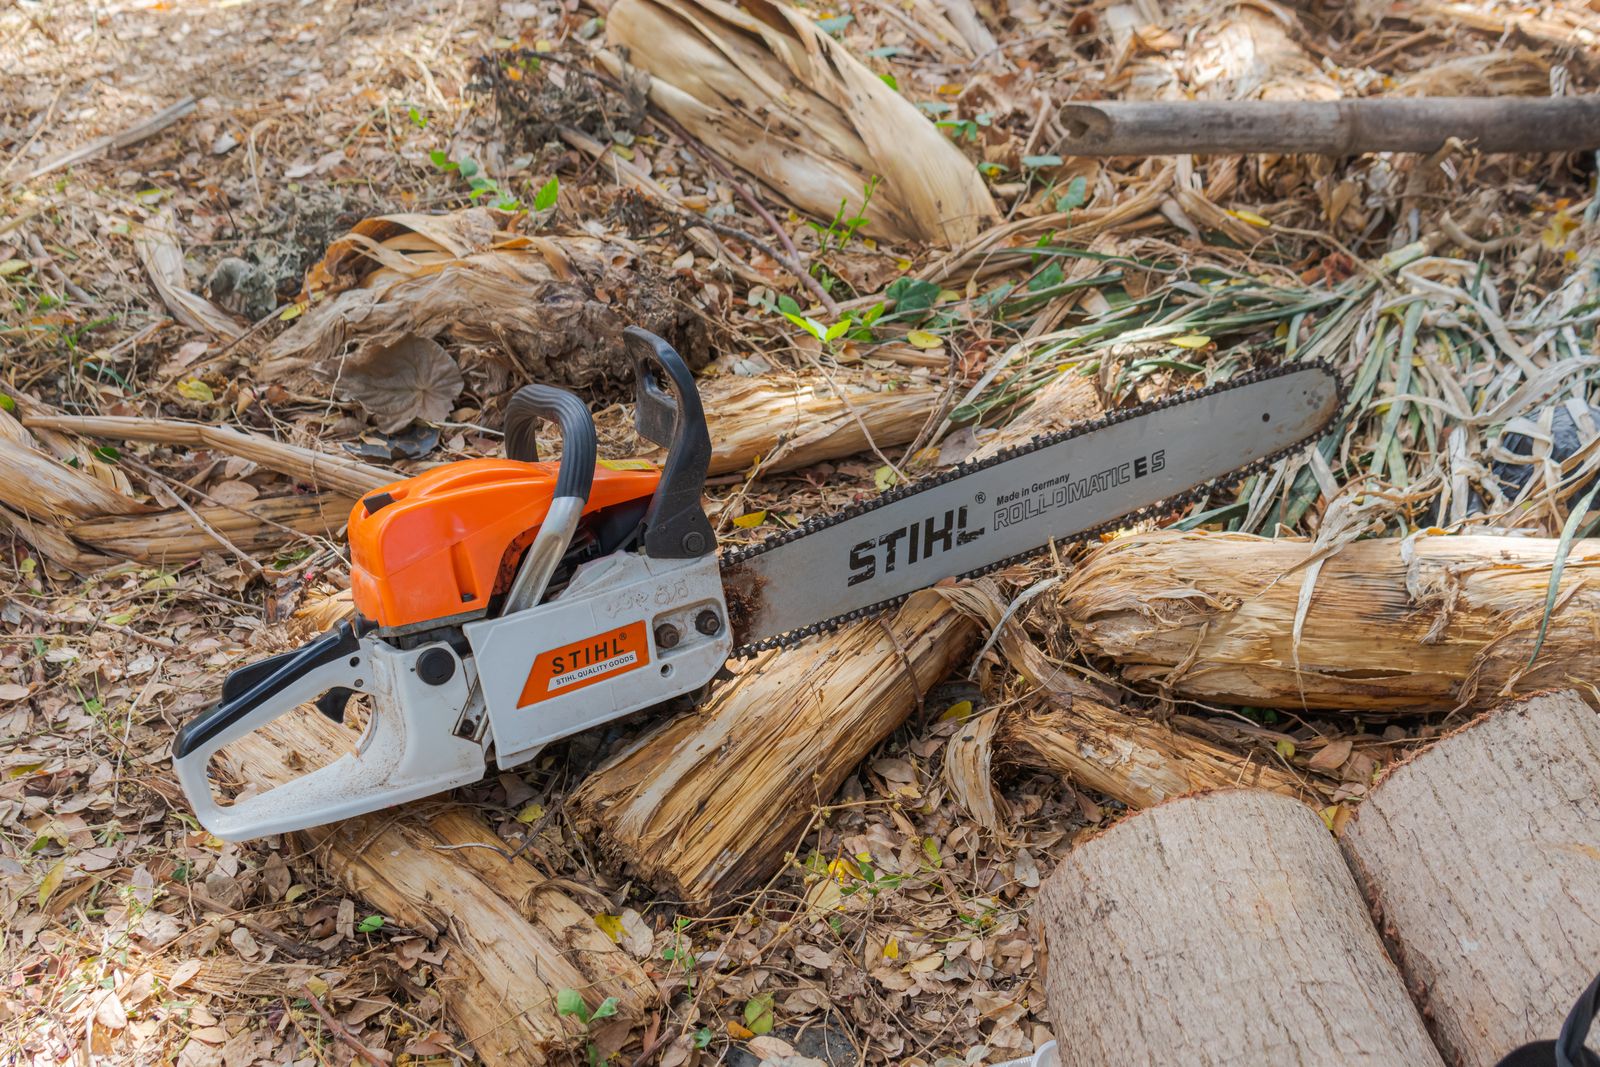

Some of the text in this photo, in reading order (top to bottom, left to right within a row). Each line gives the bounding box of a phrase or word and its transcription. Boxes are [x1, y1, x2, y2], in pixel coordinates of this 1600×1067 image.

[994, 463, 1131, 531] ROLLOMATIC
[997, 473, 1070, 506] Made in Germany
[556, 655, 634, 685] STIHL QUALITY GOODS
